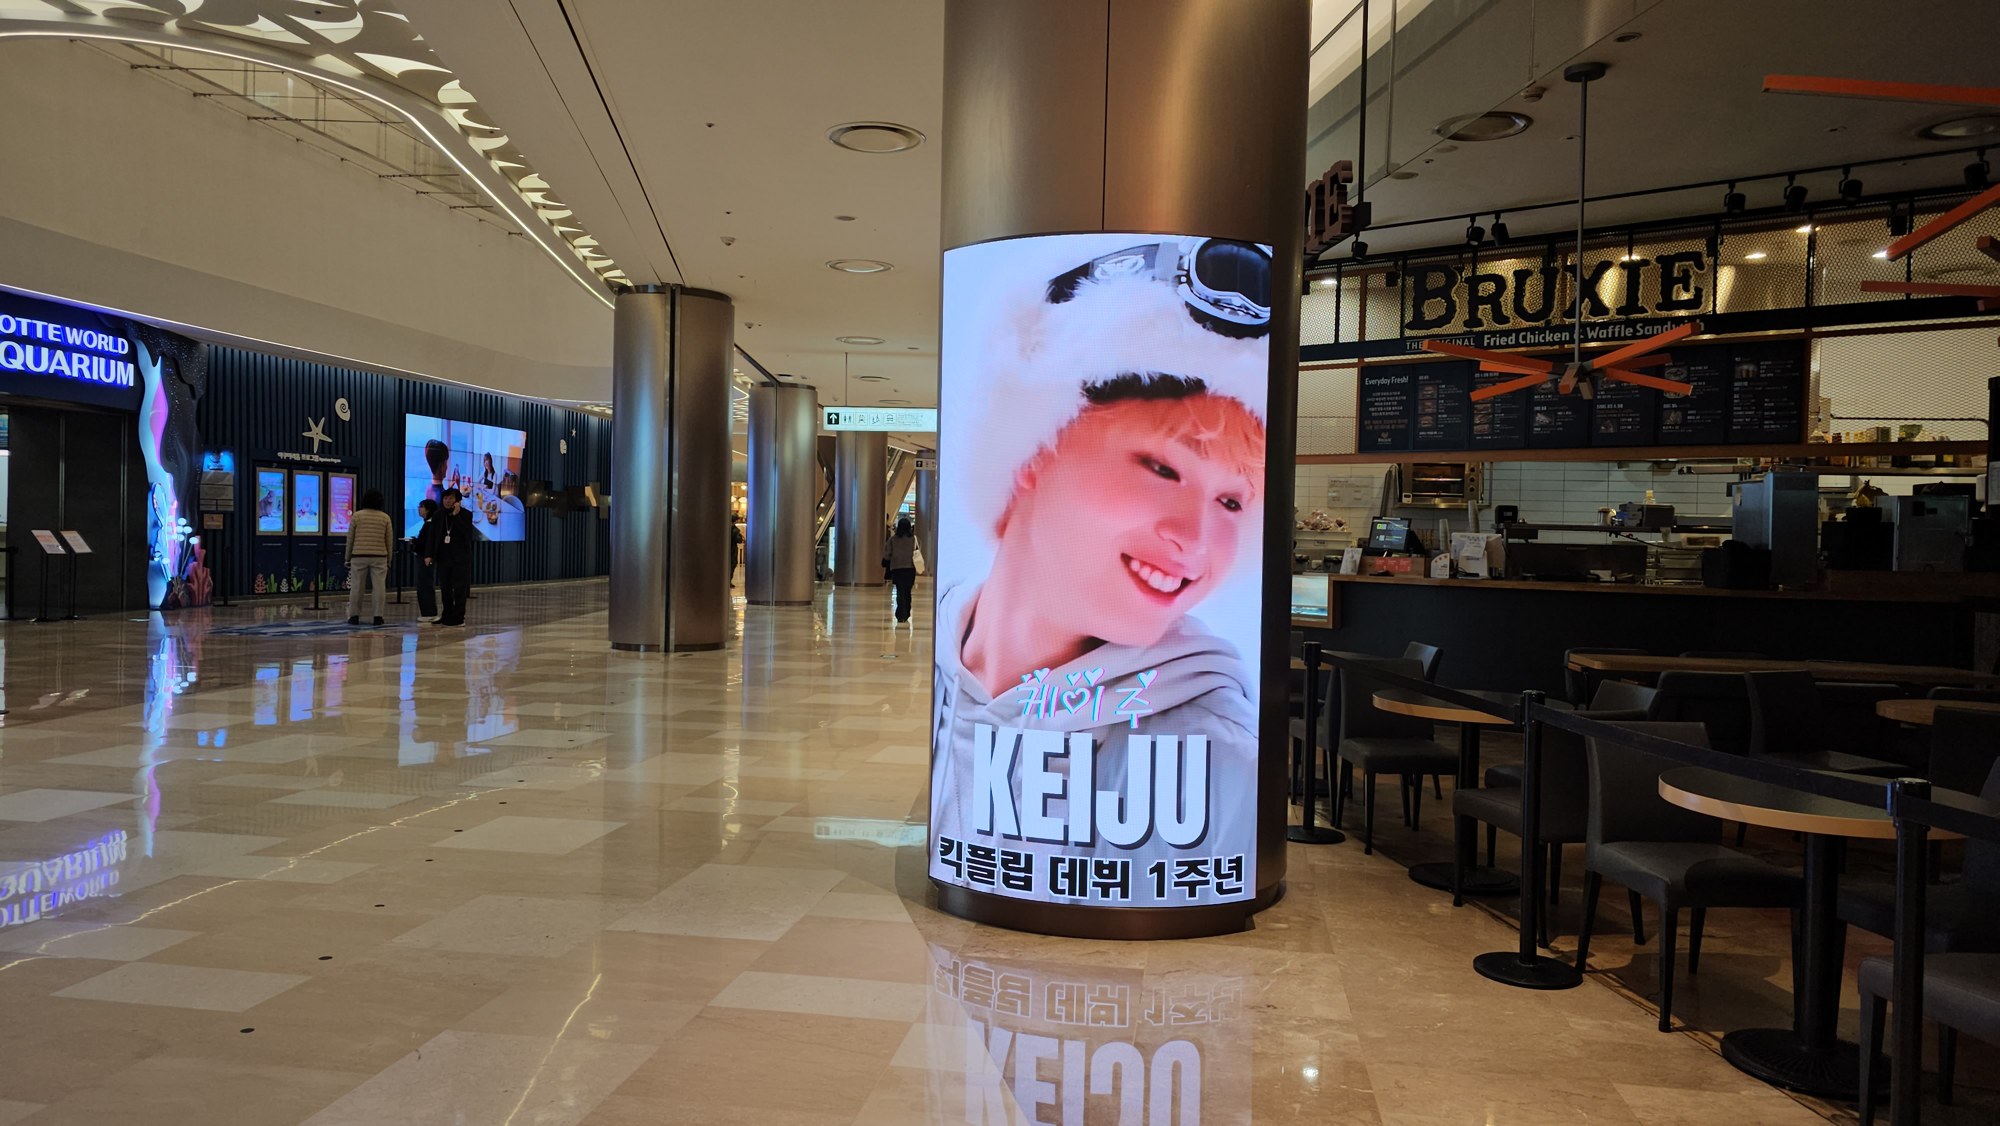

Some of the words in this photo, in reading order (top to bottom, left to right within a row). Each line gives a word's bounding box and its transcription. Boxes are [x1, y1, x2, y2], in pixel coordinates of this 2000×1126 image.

[0, 314, 61, 342] OTTE
[65, 326, 129, 355] WORLD
[1406, 341, 1424, 351] THE
[1483, 333, 1516, 347] Fried
[1519, 329, 1569, 345] Chicken
[1587, 323, 1633, 340] Waffle
[0, 341, 134, 387] QUARIUM
[1365, 377, 1391, 386] Everyday
[1392, 376, 1408, 384] Fresh!
[974, 723, 1210, 849] KEIJU
[938, 834, 1035, 893] 킥플립
[1048, 855, 1133, 900] 데뷔
[1148, 854, 1245, 900] 1주년
